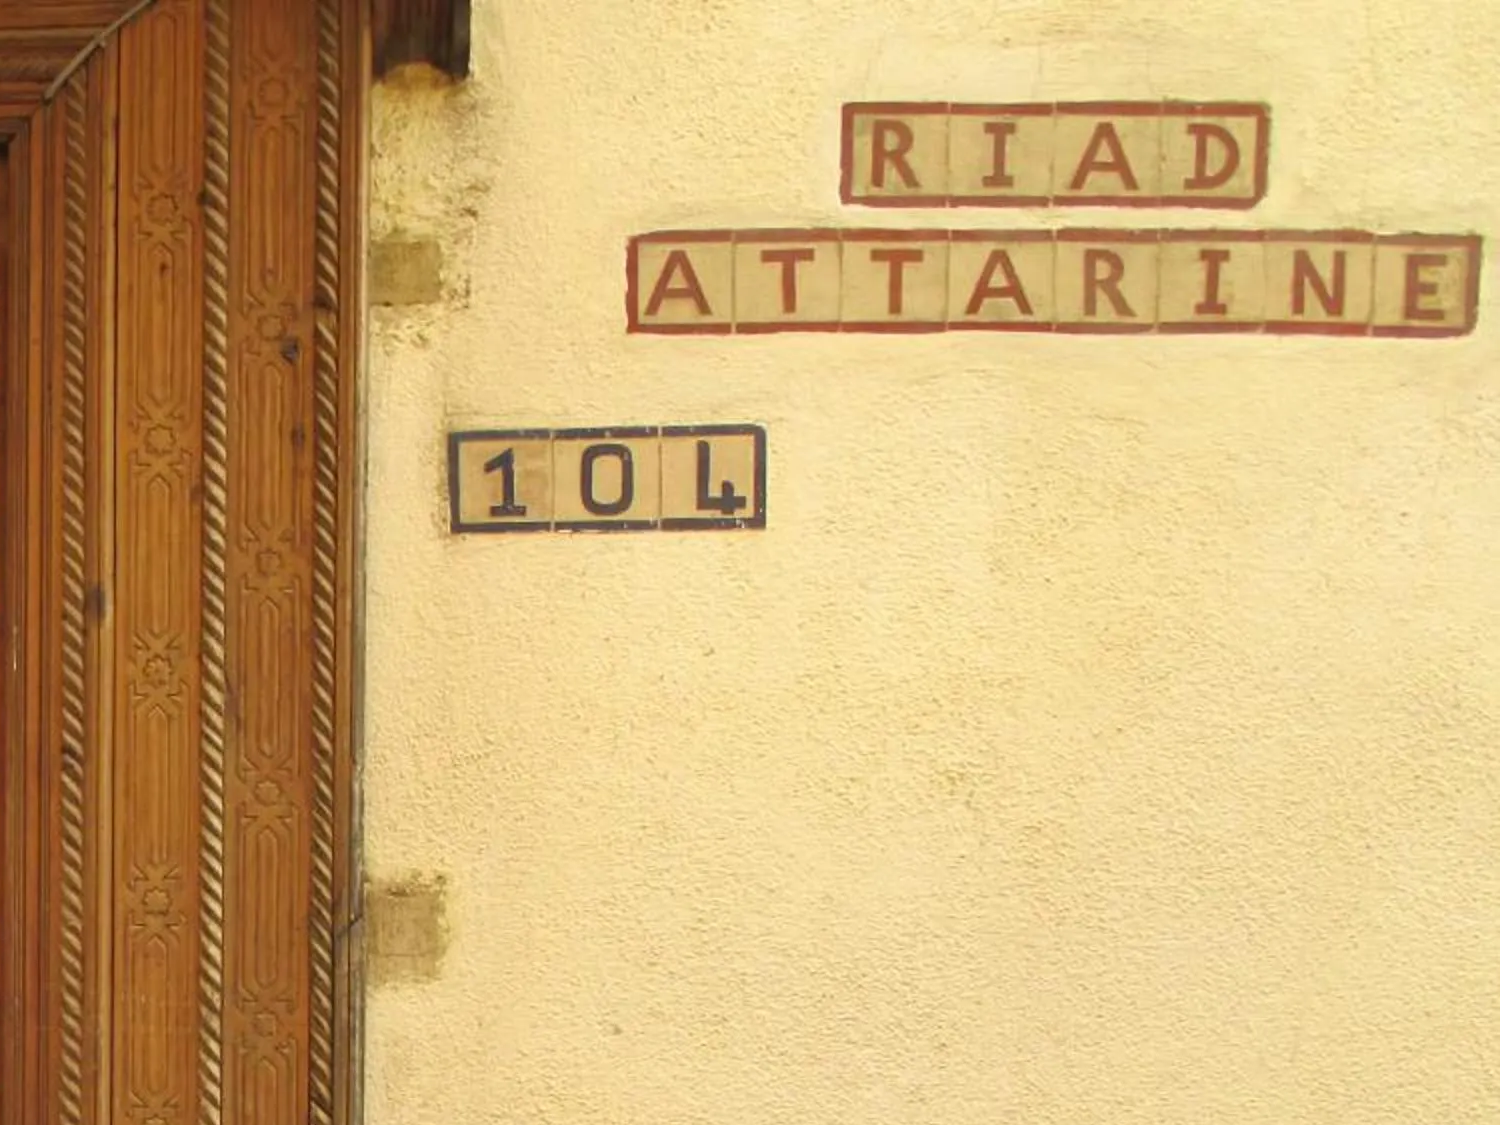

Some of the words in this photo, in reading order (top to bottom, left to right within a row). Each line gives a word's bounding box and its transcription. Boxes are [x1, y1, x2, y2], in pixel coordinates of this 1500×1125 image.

[870, 121, 1240, 190] RIAD
[644, 248, 1448, 321] ATTARINE
[483, 440, 747, 517] 104
